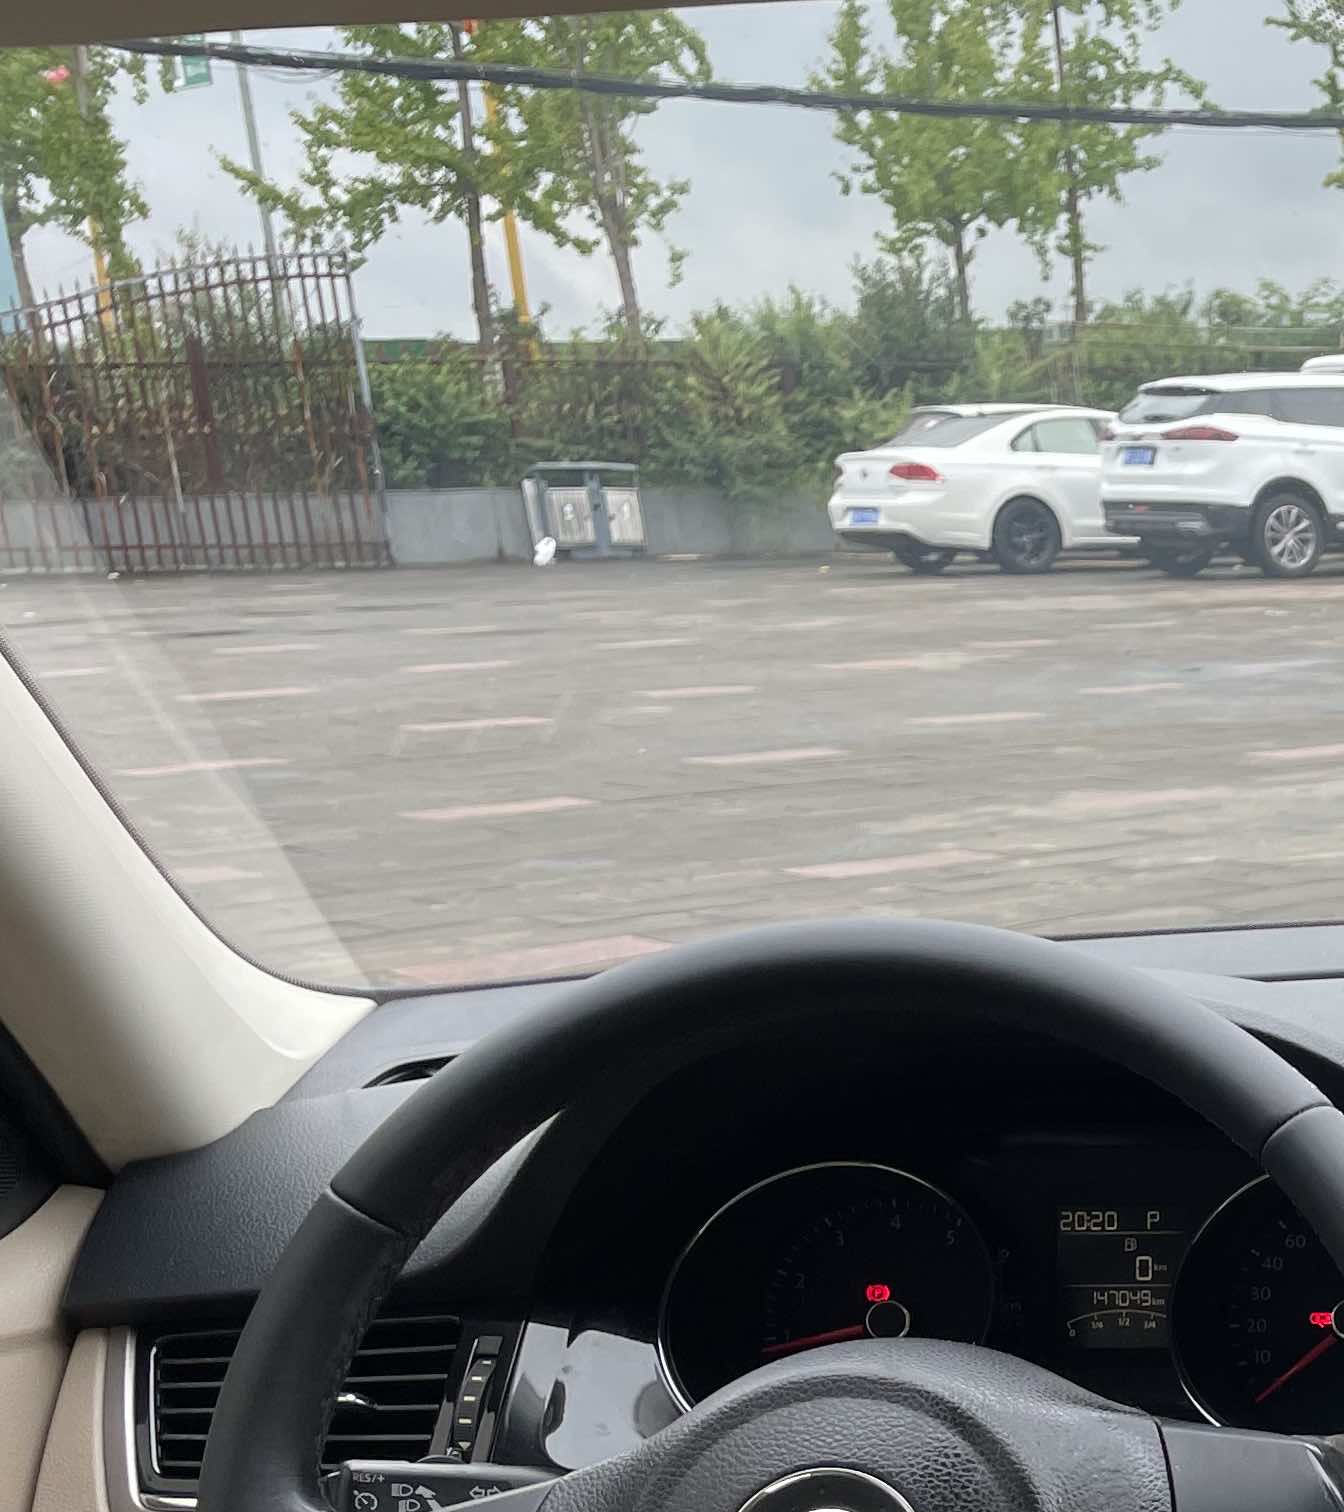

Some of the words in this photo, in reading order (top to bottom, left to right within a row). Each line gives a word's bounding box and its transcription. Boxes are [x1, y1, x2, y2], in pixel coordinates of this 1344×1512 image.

[1060, 1211, 1118, 1231] 20:20
[1147, 1211, 1160, 1230] P
[1136, 1256, 1152, 1280] 0
